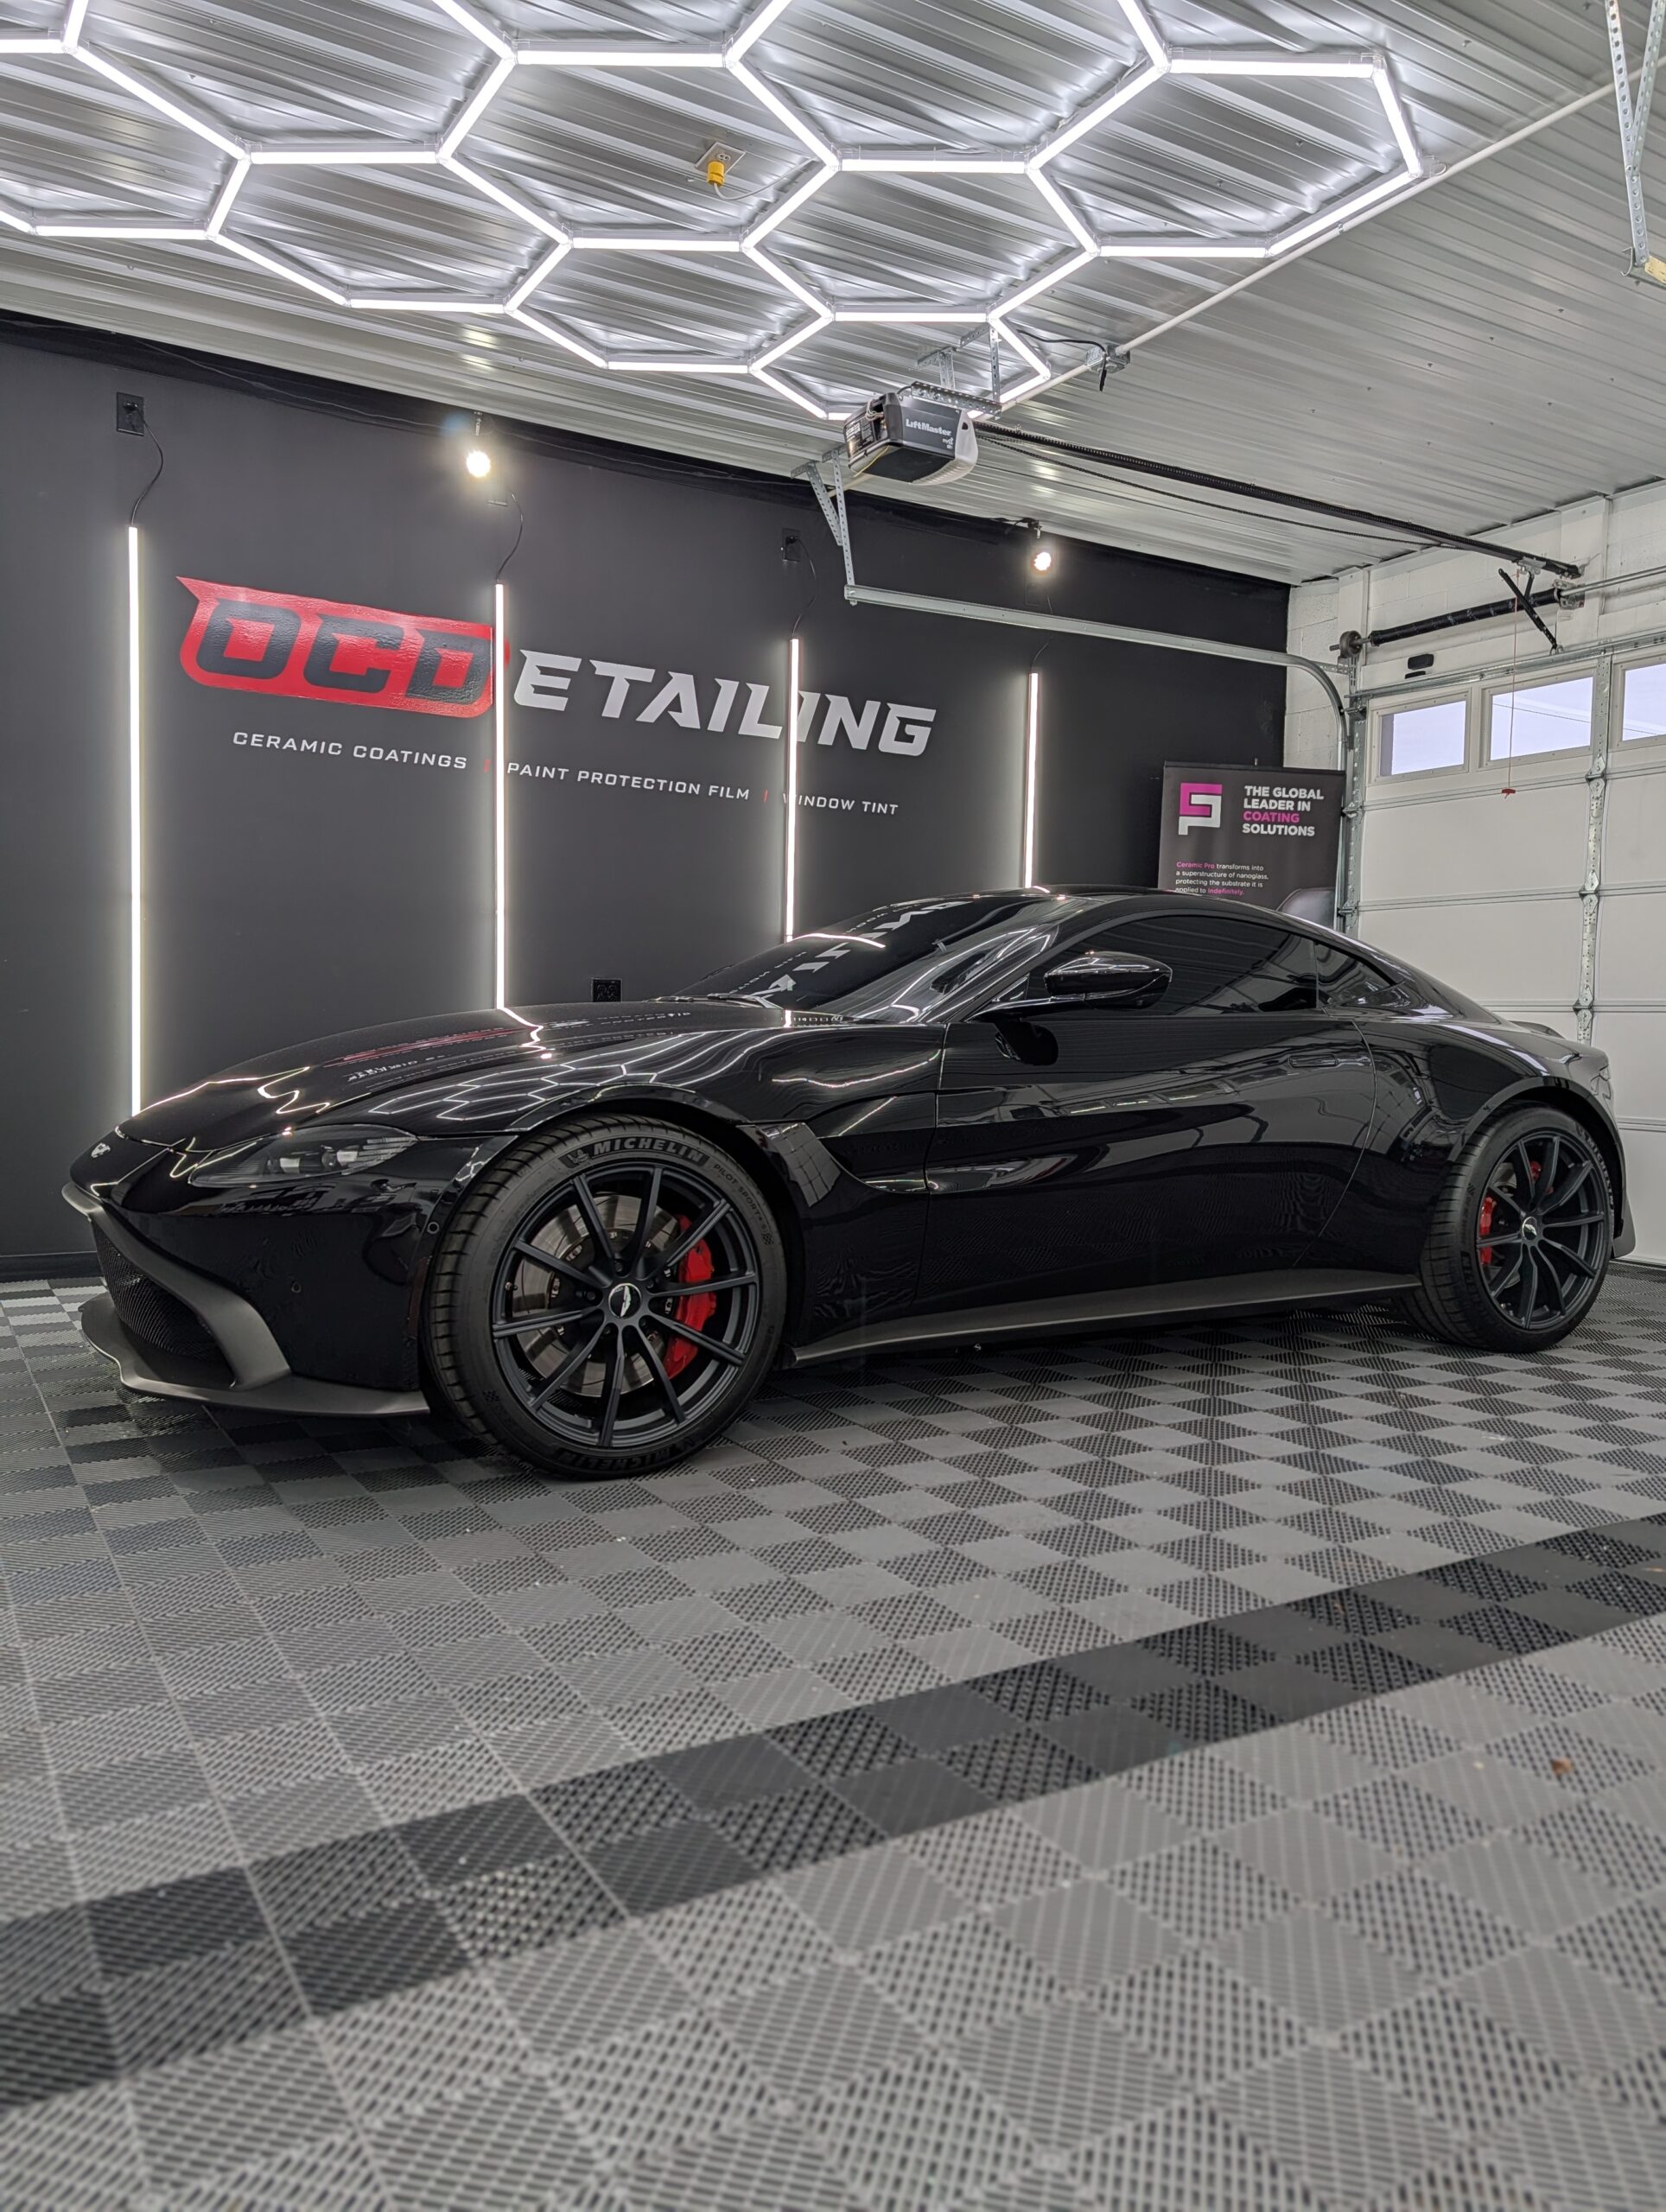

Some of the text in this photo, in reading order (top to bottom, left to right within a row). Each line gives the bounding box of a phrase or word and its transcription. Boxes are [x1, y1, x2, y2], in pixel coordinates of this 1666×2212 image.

[906, 419, 952, 435] LiftMaster
[196, 599, 493, 704] OCD
[232, 731, 343, 756] CERAMIC
[353, 745, 467, 770] COATINGS
[507, 762, 569, 780] PAINT
[576, 770, 701, 796] PROTECTION
[709, 784, 750, 801] FILM
[862, 800, 900, 815] TINT
[1244, 785, 1325, 800] THE GLOBAL
[1243, 798, 1312, 811] LEADER IN
[1243, 810, 1300, 823] COATING
[1242, 823, 1315, 836] SOLUTIONS
[1181, 870, 1227, 879] superstructure
[593, 1137, 704, 1162] MICHELIN
[713, 1163, 761, 1216] PILOT SPORT
